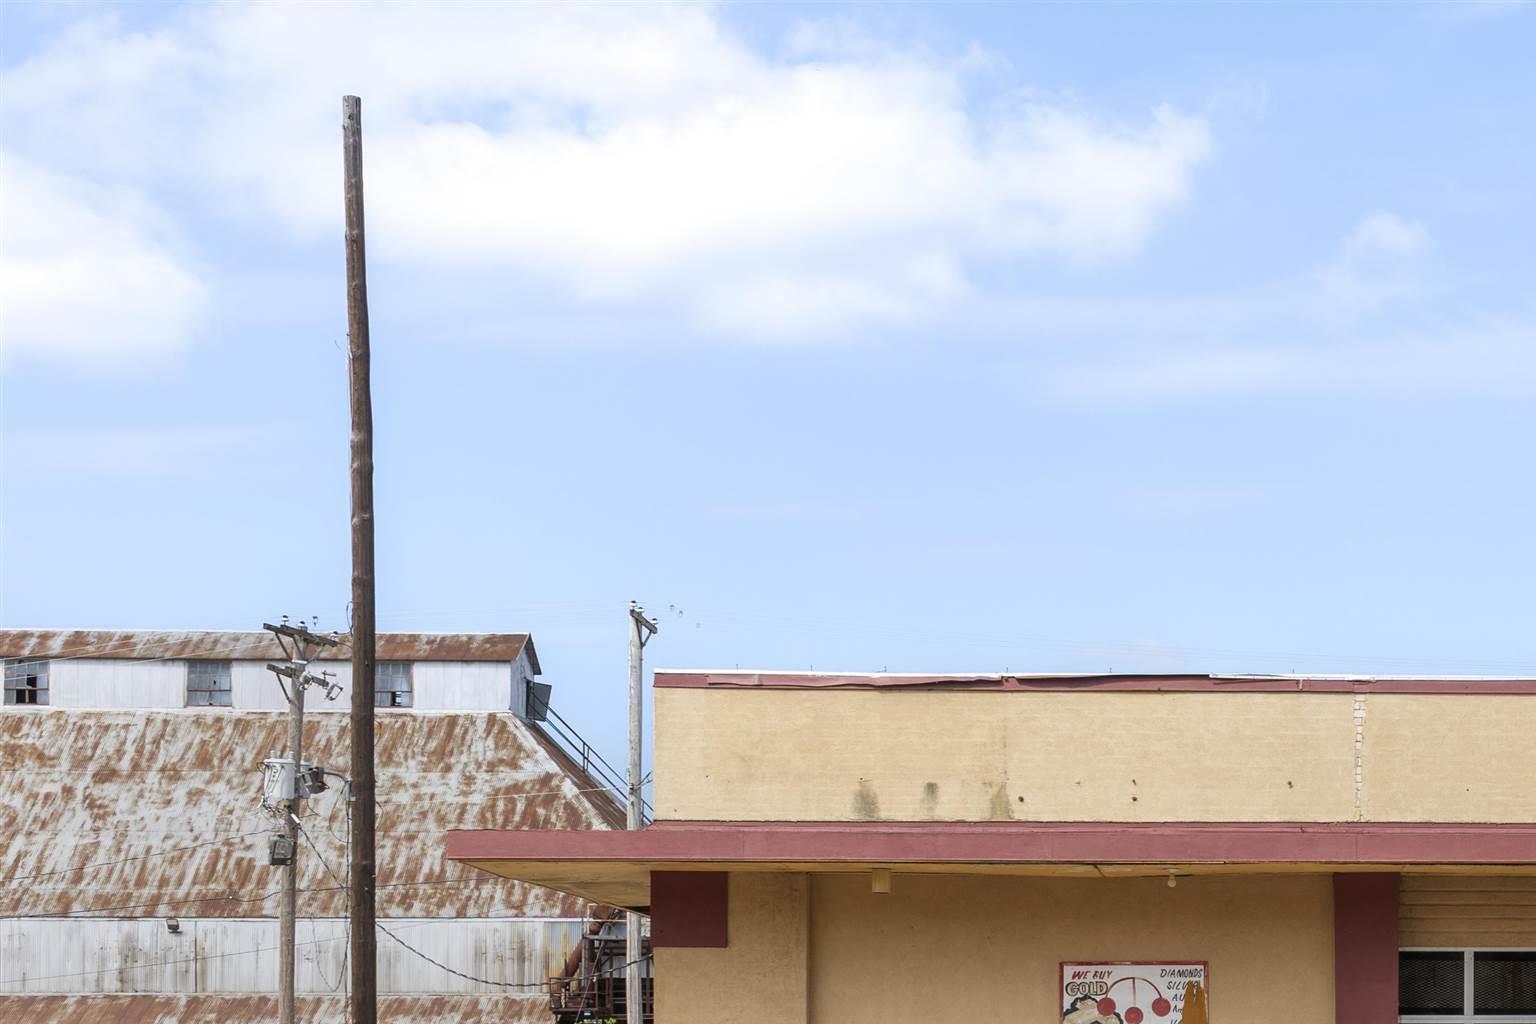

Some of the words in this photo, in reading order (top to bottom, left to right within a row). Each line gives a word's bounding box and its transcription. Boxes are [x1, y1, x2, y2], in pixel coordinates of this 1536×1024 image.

[1072, 970, 1091, 980] WE
[1092, 970, 1112, 980] BUY
[1160, 968, 1203, 979] DIAMONDS
[1065, 981, 1108, 996] GOLD
